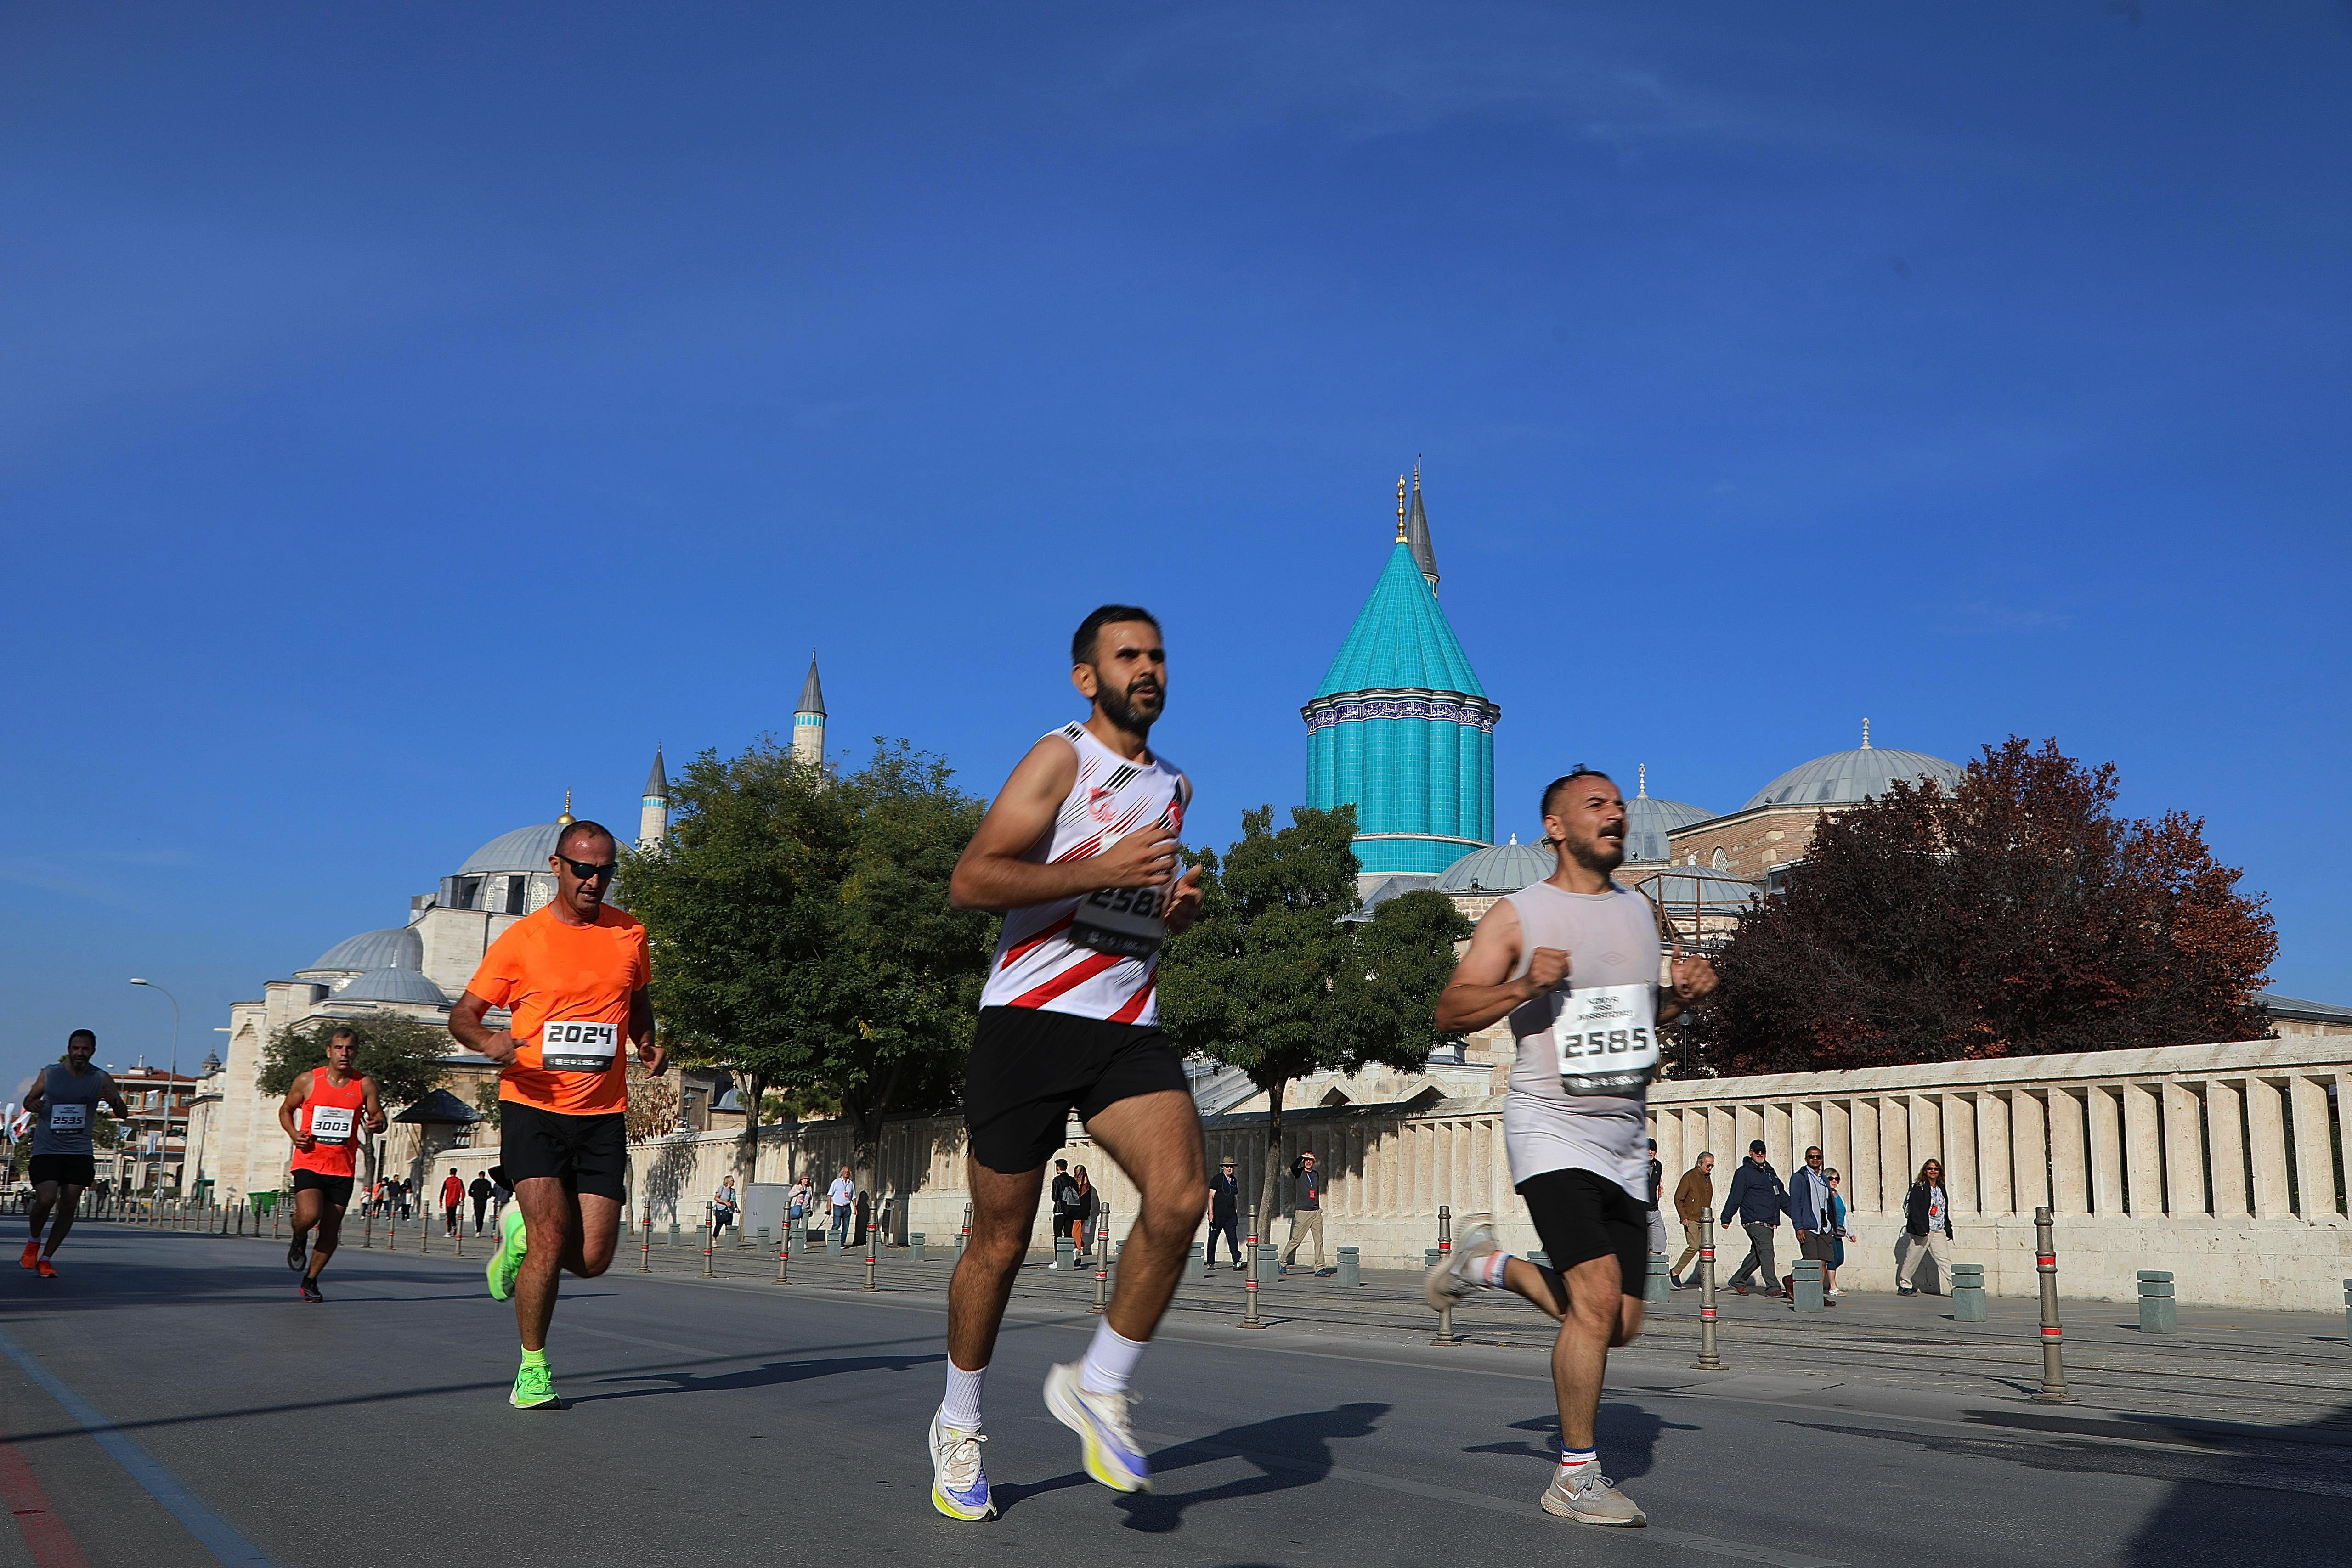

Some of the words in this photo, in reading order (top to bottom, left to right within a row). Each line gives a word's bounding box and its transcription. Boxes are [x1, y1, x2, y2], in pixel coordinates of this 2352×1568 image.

[548, 1025, 612, 1044] 2024
[1566, 1027, 1646, 1058] 2585
[313, 1121, 349, 1131] 3003
